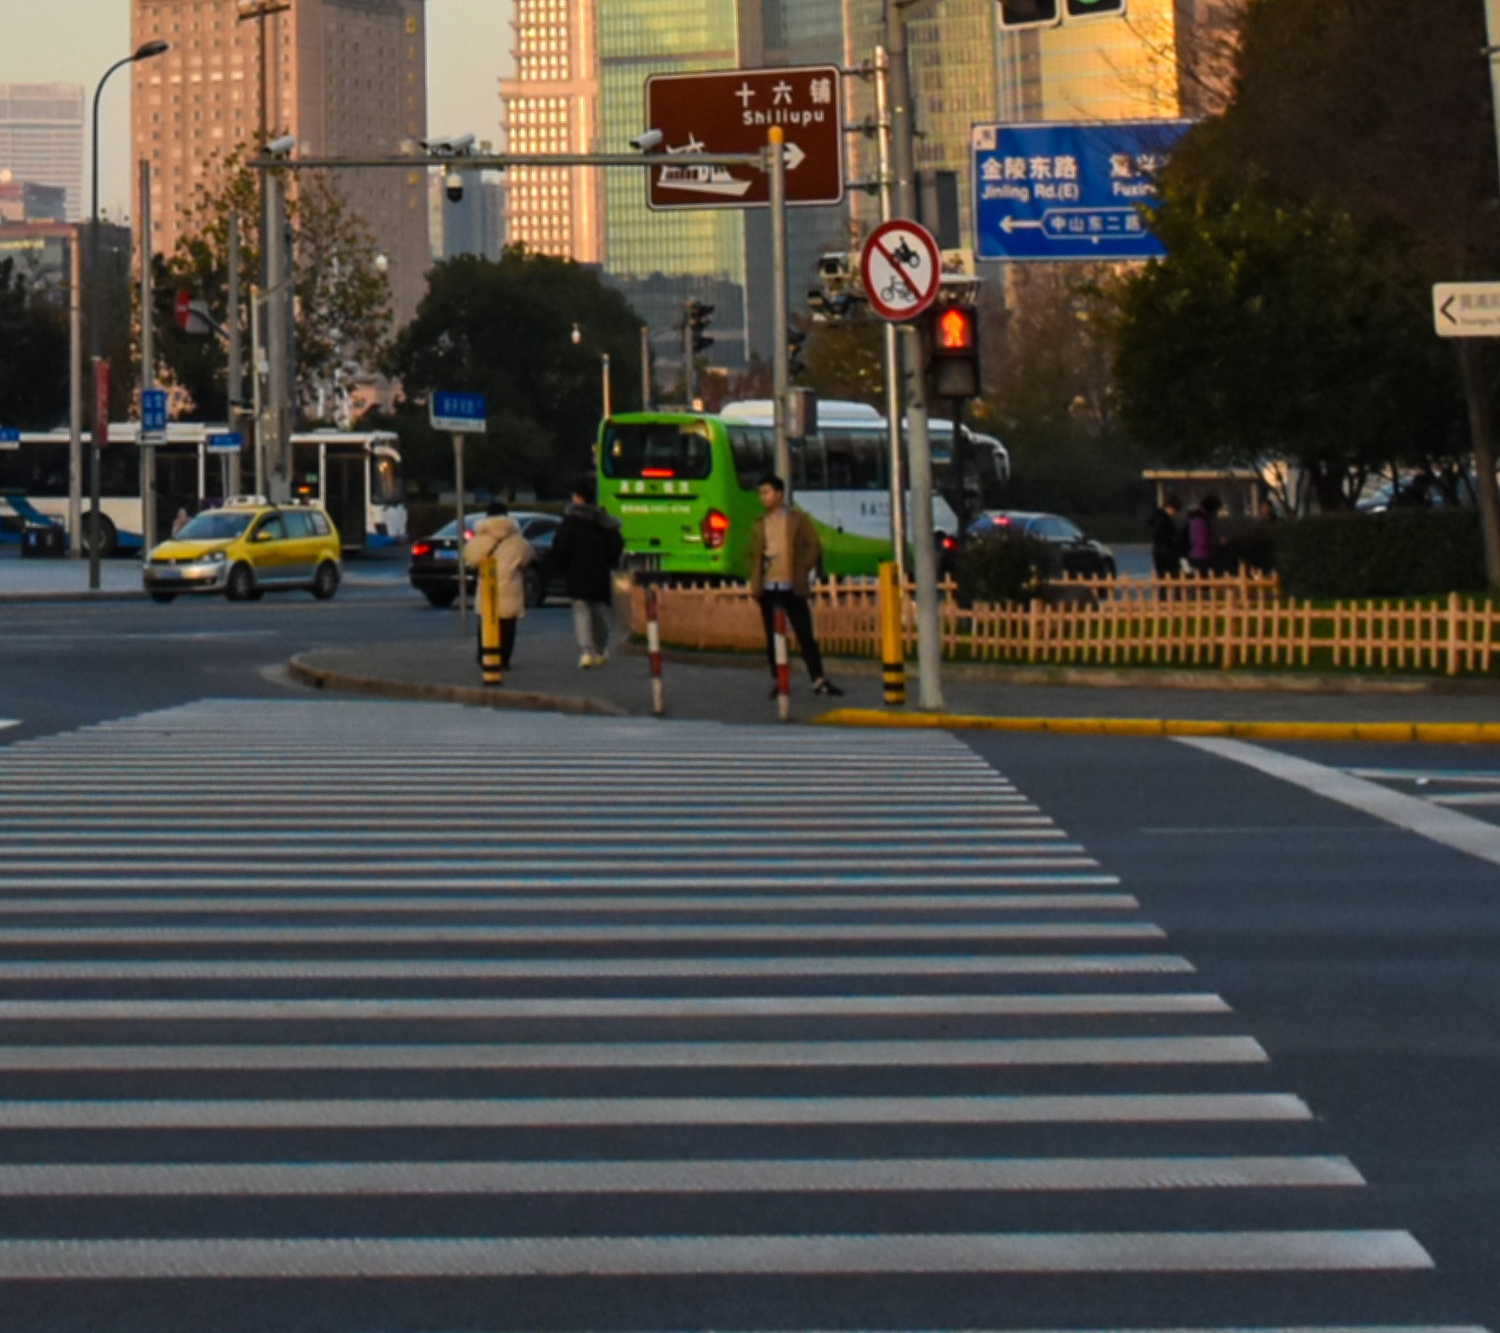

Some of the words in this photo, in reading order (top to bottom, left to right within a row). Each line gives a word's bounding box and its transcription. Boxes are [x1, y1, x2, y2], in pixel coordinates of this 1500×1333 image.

[735, 77, 832, 108] 十六铺
[742, 109, 825, 127] Shiliupu
[981, 155, 1078, 181] 金陵东路
[981, 184, 1030, 202] Jinling
[1051, 215, 1141, 232] 中山东二路
